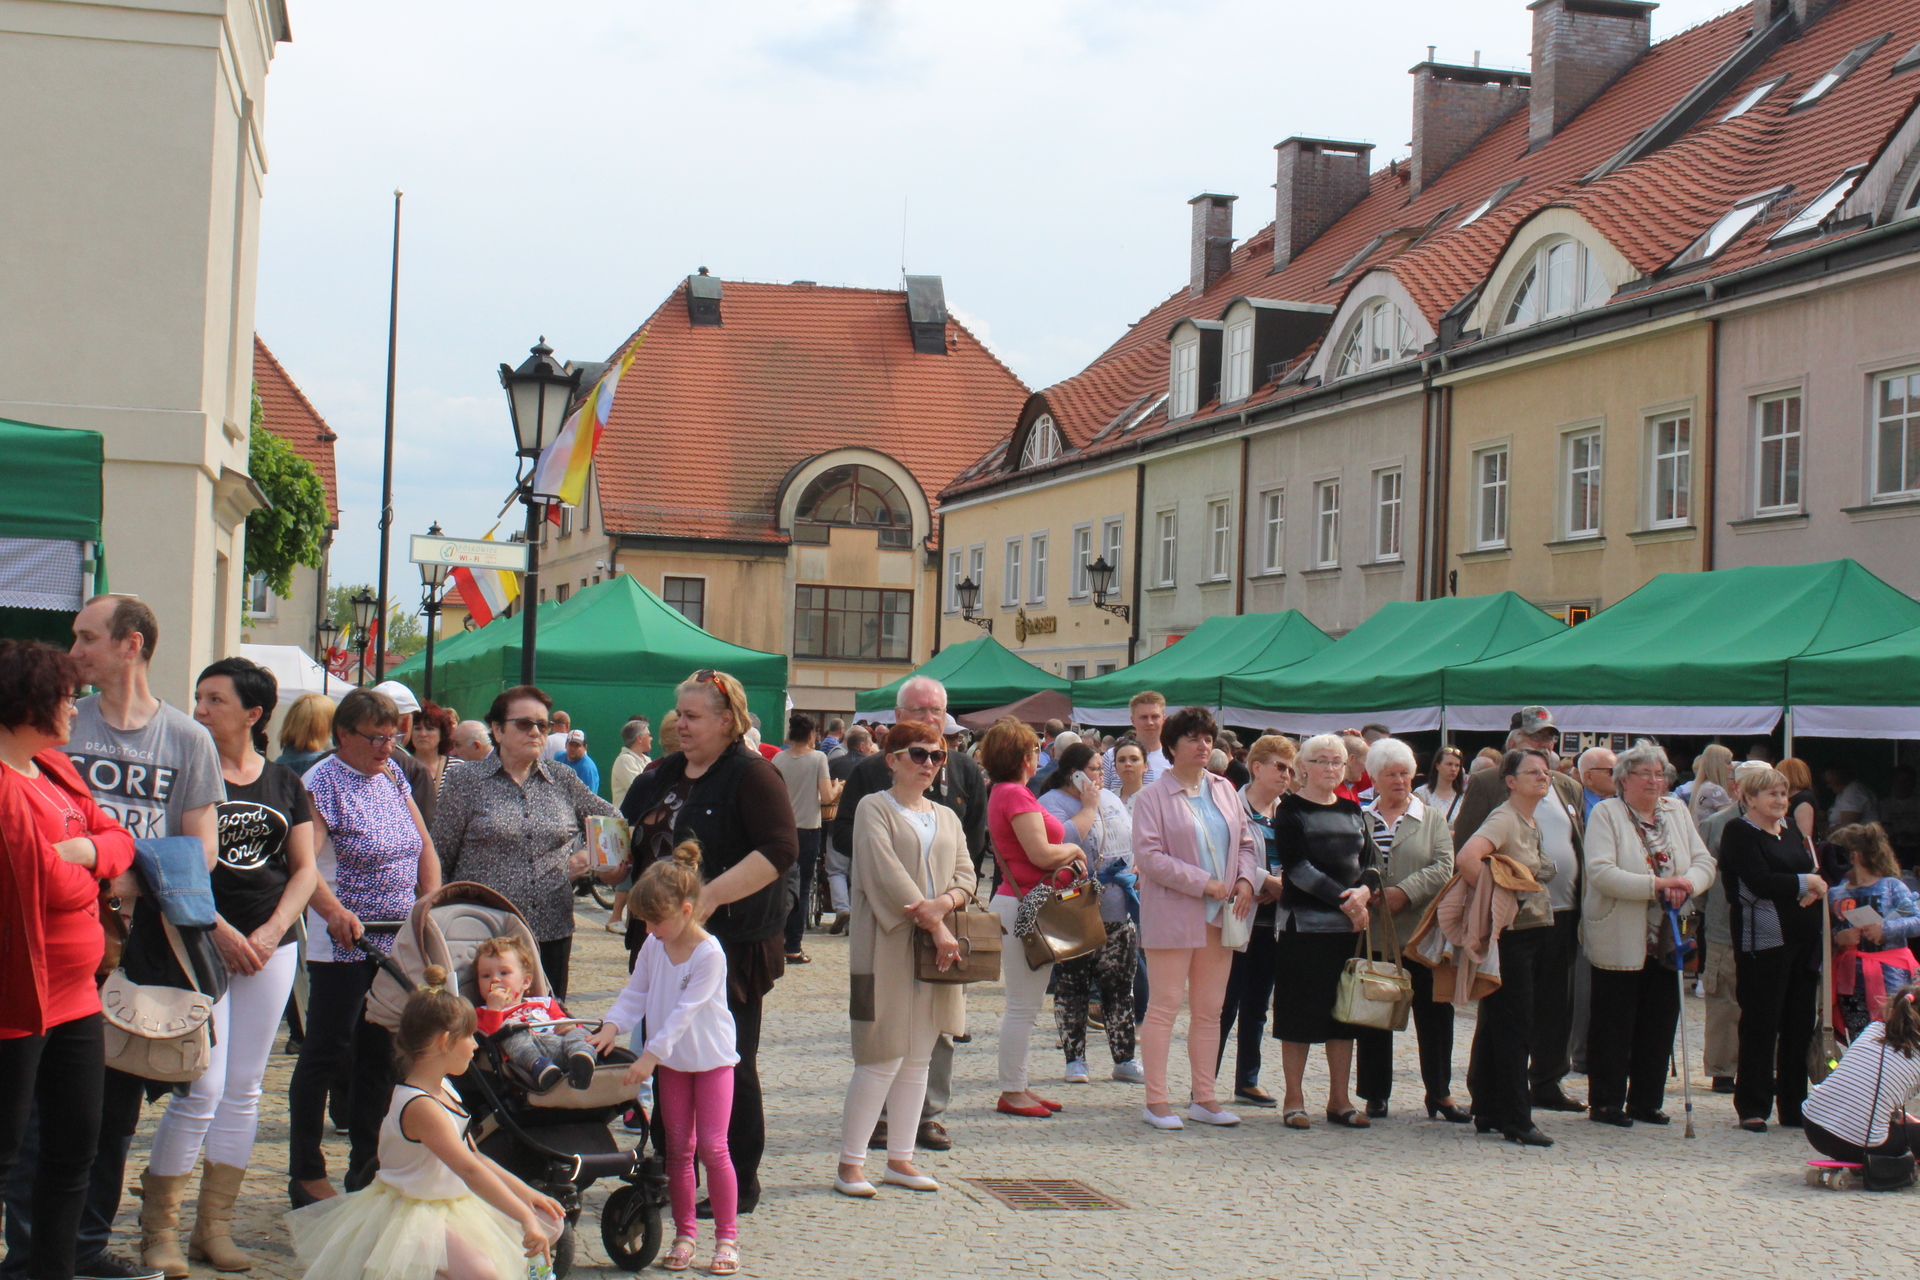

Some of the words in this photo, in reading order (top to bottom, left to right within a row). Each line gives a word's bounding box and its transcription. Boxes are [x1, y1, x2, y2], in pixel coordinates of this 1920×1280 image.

[335, 671, 346, 680] 24
[85, 741, 154, 760] DEADSTOCK
[218, 807, 267, 833] good
[221, 824, 273, 846] vibes
[227, 838, 267, 863] only
